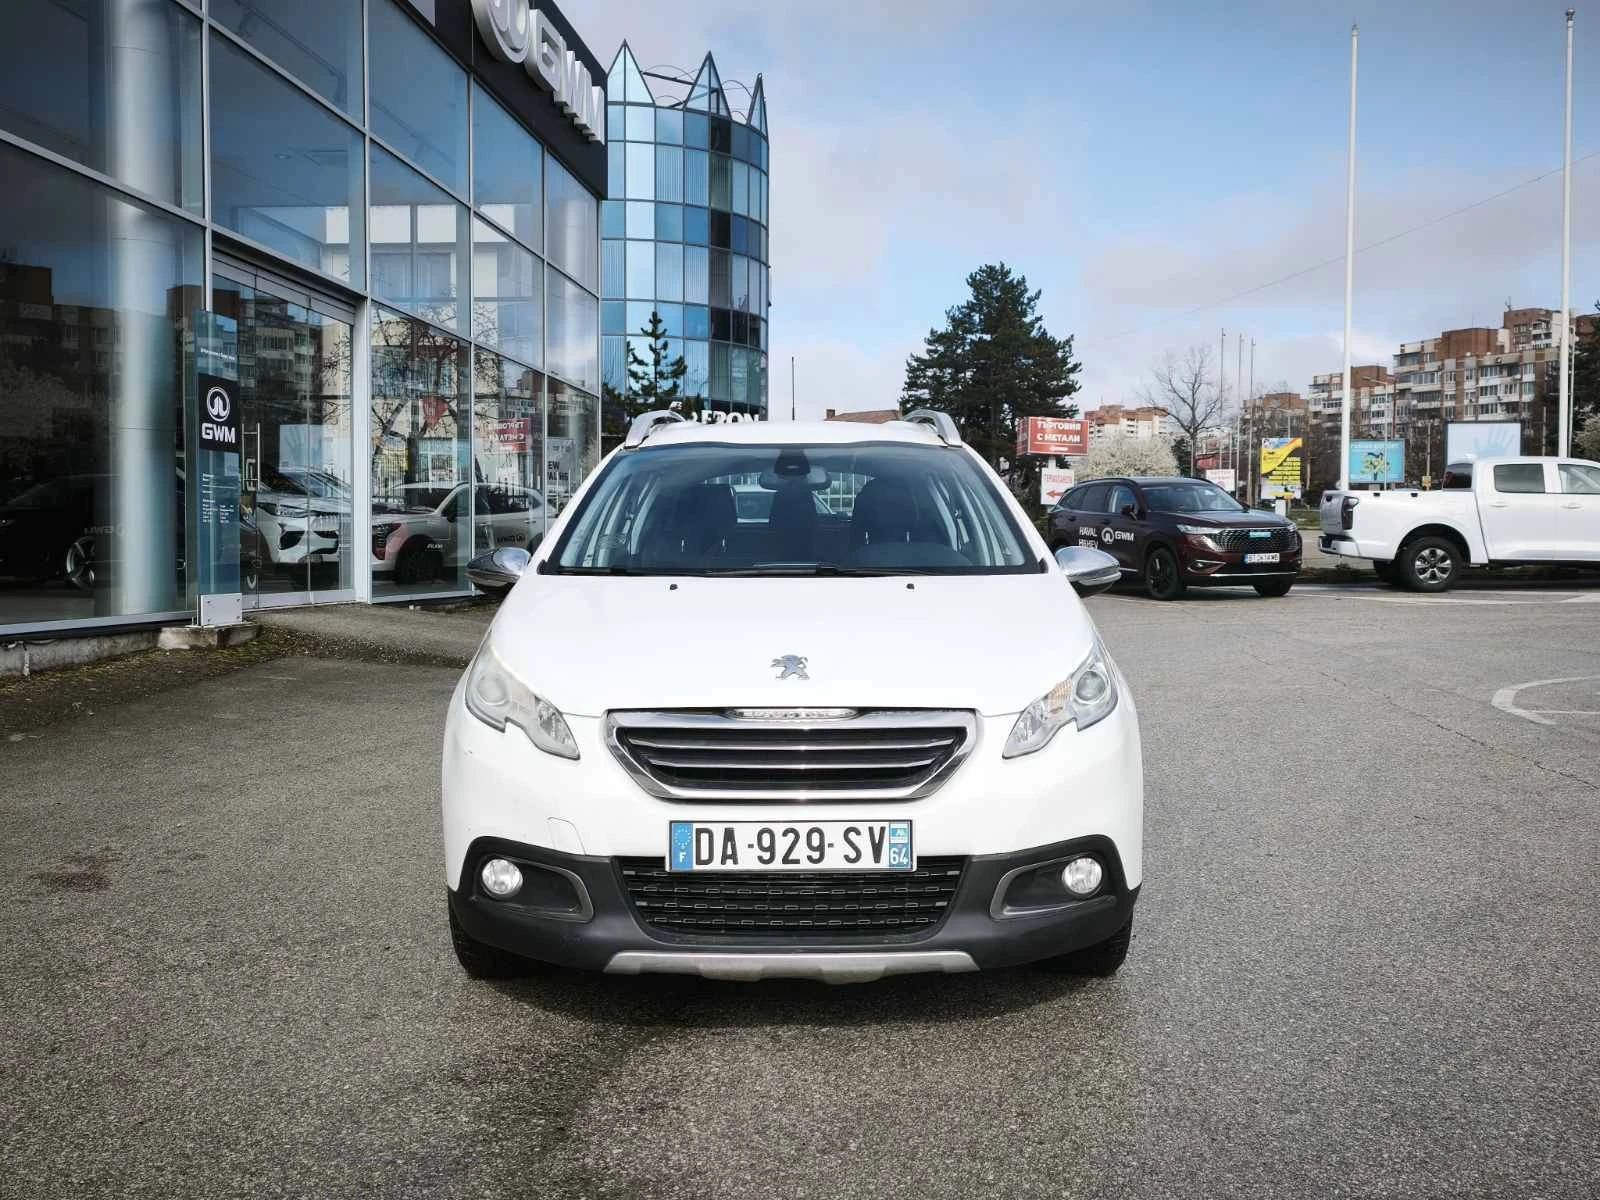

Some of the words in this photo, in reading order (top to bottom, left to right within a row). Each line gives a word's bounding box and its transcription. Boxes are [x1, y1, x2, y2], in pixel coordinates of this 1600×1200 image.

[201, 422, 236, 443] GWM
[1079, 526, 1098, 537] HAVAL
[1115, 530, 1135, 541] GWM
[679, 852, 687, 864] F
[695, 826, 887, 866] DA-929-SV
[890, 847, 909, 865] 64
